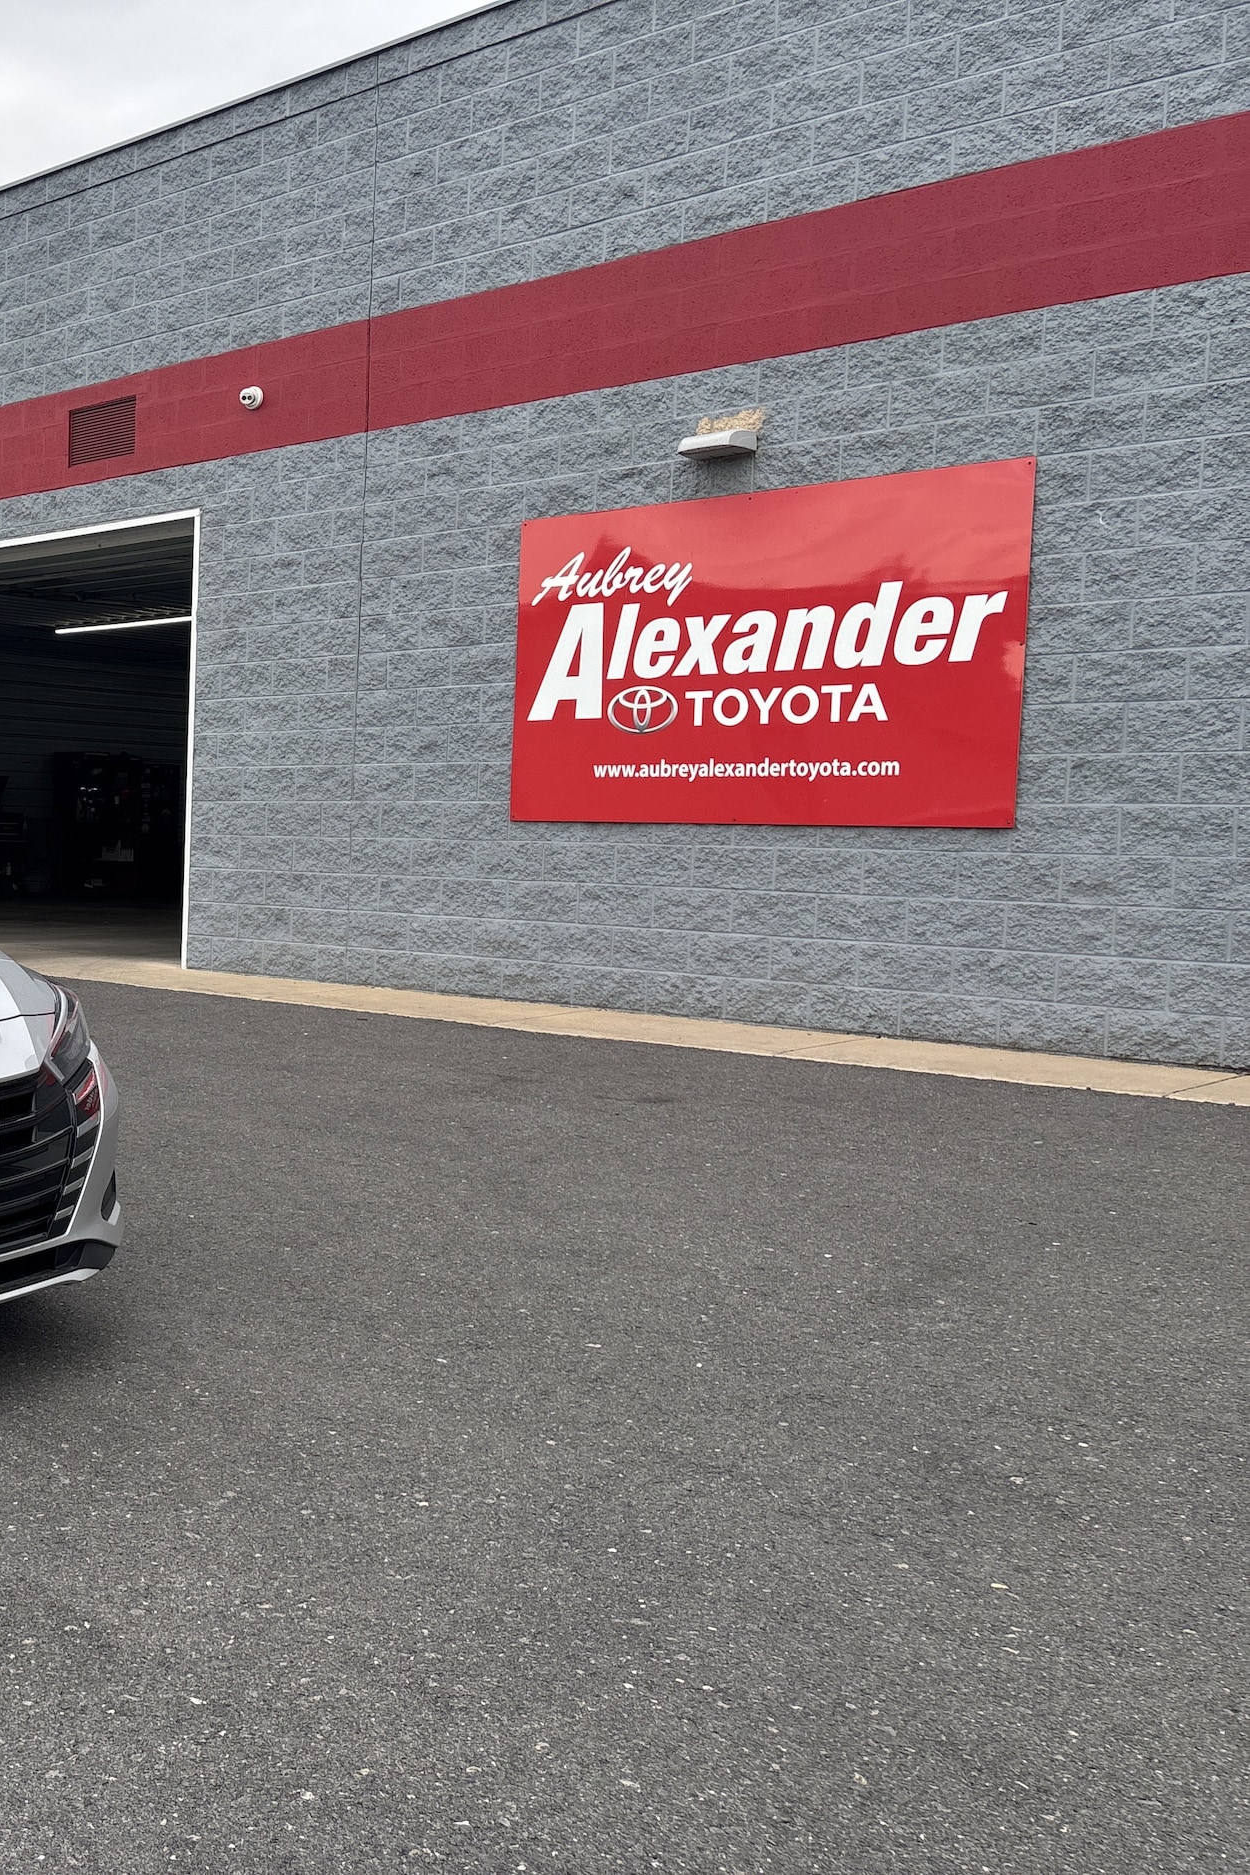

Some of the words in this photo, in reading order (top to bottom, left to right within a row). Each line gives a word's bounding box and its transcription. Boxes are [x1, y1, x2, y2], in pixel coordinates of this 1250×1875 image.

[531, 546, 693, 607] Aubrey
[527, 580, 1008, 721] Alexander
[684, 683, 888, 727] TOYOTA
[593, 757, 900, 783] www.aubreyalexandertoyota.com
